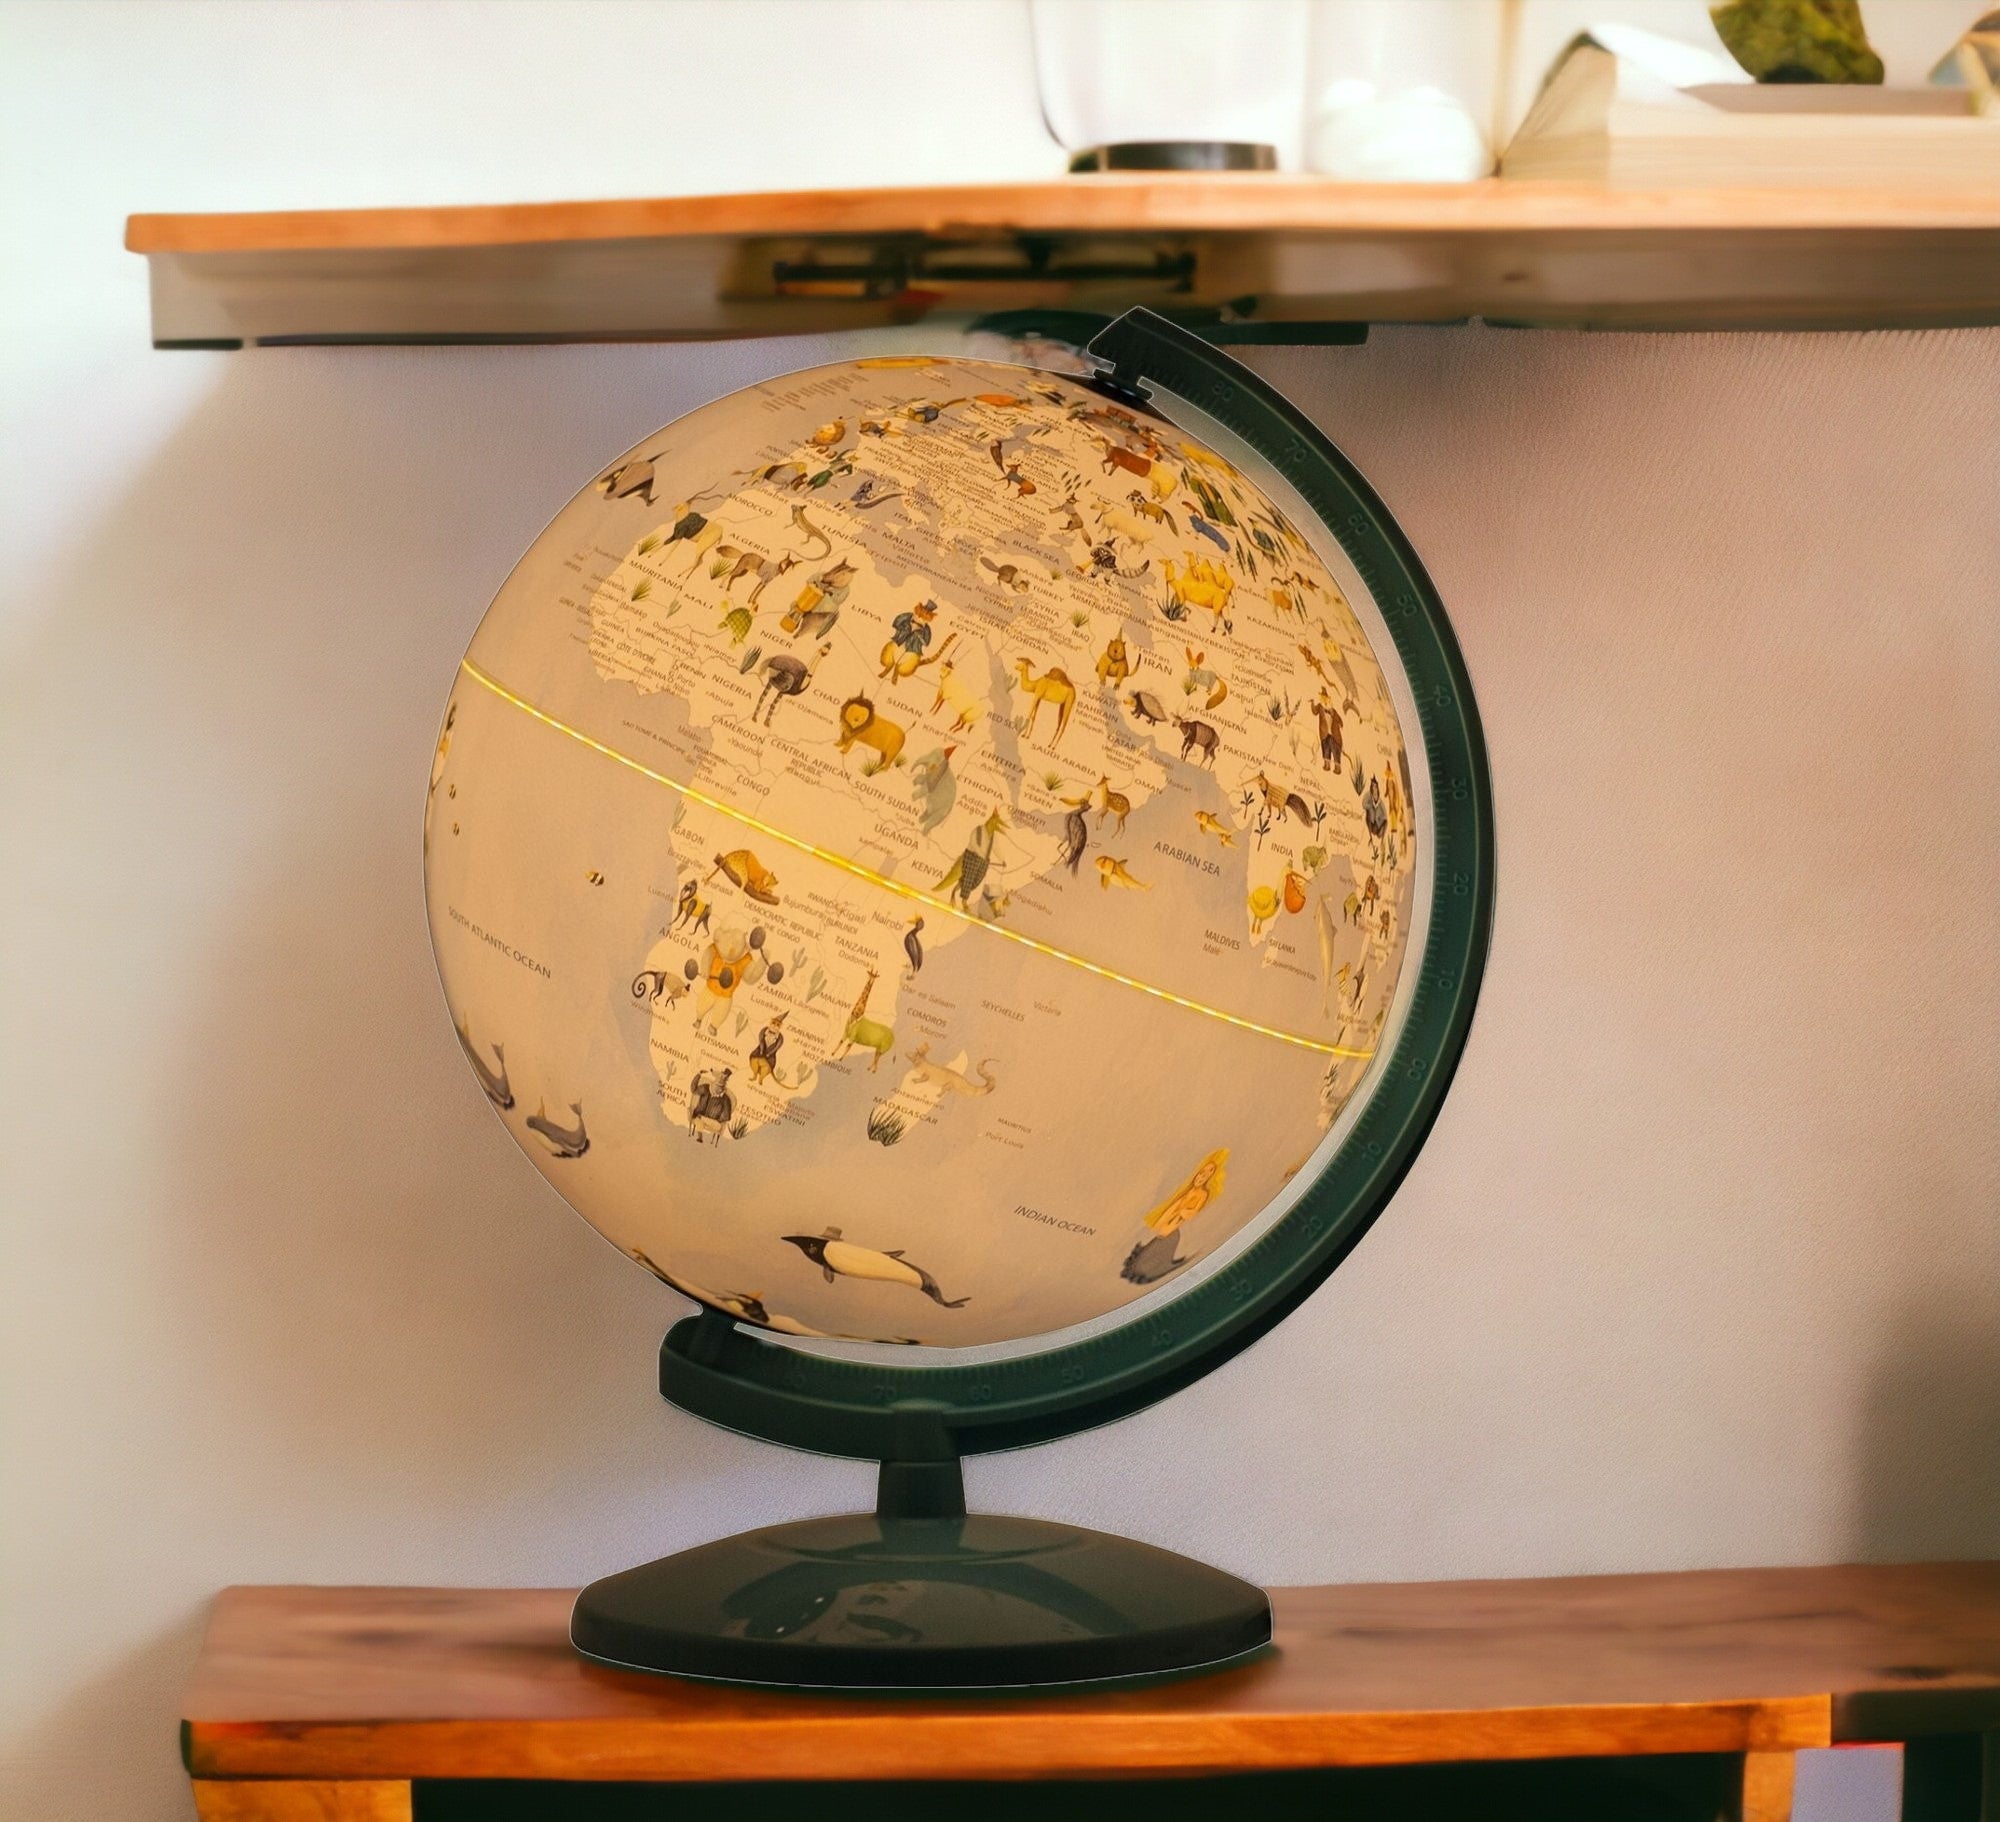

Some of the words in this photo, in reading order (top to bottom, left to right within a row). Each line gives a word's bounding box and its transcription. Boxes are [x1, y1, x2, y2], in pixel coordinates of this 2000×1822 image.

[728, 493, 774, 517] MOROCCO
[808, 498, 843, 517] Algiers
[729, 532, 771, 555] ALGERIA
[821, 524, 868, 548] TUNISIA
[882, 532, 915, 550] MALTA
[1012, 540, 1041, 558] BLACK
[1042, 552, 1060, 565] SEA
[628, 560, 684, 591] MAURITANIA
[896, 554, 960, 587] MEDITERRANEAN
[959, 582, 973, 593] SEA
[1065, 569, 1099, 588] GEORGIA
[683, 593, 714, 610] MALI
[1031, 586, 1065, 602] TURKEY
[1070, 592, 1105, 612] ARMENIA
[851, 604, 882, 623] LIBYA
[983, 596, 1014, 614] CYPRUS
[1020, 605, 1054, 624] LEBANON
[1034, 601, 1060, 618] SYRIA
[949, 621, 985, 640] EGYPT
[979, 616, 1009, 635] ISRAEL
[1071, 629, 1091, 643] IRAQ
[1246, 615, 1295, 640] KAZAKHSTAN
[635, 626, 669, 648] BURKINA
[760, 630, 793, 649] NIGER
[1010, 634, 1049, 655] JORDAN
[1199, 634, 1246, 659] UZBEKISTAN
[679, 662, 706, 679] BENIN
[1142, 657, 1173, 676] IRAN
[712, 673, 752, 700] NIGERIA
[813, 687, 841, 706] CHAD
[887, 697, 923, 718] SUDAN
[1082, 691, 1117, 710] KUWAIT
[987, 711, 1003, 724] RED
[1077, 701, 1119, 723] BAHRAIN
[1188, 705, 1247, 735] AFGHANISTAN
[712, 714, 766, 745] CAMEROON
[923, 724, 967, 746] Khartoum
[1107, 734, 1136, 751] QATAR
[770, 739, 809, 762] CENTRAL
[812, 758, 852, 781] AFRICAN
[981, 750, 1026, 775] ERITREA
[1031, 743, 1060, 760] SAUDI
[1061, 757, 1097, 777] ARABIA
[1223, 744, 1263, 766] PAKISTAN
[791, 758, 825, 778] REPUBLIC
[736, 774, 771, 796] CONGO
[957, 774, 1003, 800] ETHIOPIA
[1134, 778, 1163, 795] OMAN
[1452, 777, 1468, 799] 30
[854, 781, 888, 801] SOUTH
[887, 796, 920, 817] SUDAN
[1023, 791, 1053, 809] YEMEN
[1007, 804, 1046, 826] DJIBOUTI
[673, 825, 705, 845] GABON
[874, 823, 919, 850] UGANDA
[1153, 840, 1201, 869] ARABIAN
[1201, 859, 1222, 876] SEA
[1270, 842, 1294, 858] INDIA
[911, 859, 945, 879] KENYA
[1029, 870, 1064, 892] SOMALIA
[1454, 874, 1469, 895] 20
[808, 892, 840, 911] RWANDA
[744, 901, 788, 926] DEMOCRATIC
[789, 921, 823, 942] REPUBLIC
[826, 917, 859, 935] BURUNDI
[872, 911, 905, 931] Nairobi
[448, 905, 470, 929] SOUTH
[471, 924, 512, 958] ATLANTIC
[513, 950, 551, 979] OCEAN
[659, 927, 700, 952] ANGOLA
[835, 935, 879, 960] TANZANIA
[1204, 928, 1241, 951] MALDIVES
[1277, 941, 1296, 955] LANKA
[757, 983, 793, 1003] ZAMBIA
[819, 991, 851, 1010] MALAWI
[906, 1008, 947, 1028] COMOROS
[981, 1000, 1026, 1022] SEYCHELLES
[695, 1031, 739, 1056] BOTSWANA
[786, 1024, 825, 1045] ZIMBABWE
[650, 1038, 690, 1063] NAMIBIA
[802, 1050, 852, 1076] MOZAMBIQUE
[657, 1090, 687, 1108] AFRICA
[658, 1080, 687, 1098] SOUTH
[872, 1096, 938, 1125] MADAGASCAR
[1013, 1205, 1058, 1227] INDIAN
[1057, 1220, 1096, 1236] OCEAN
